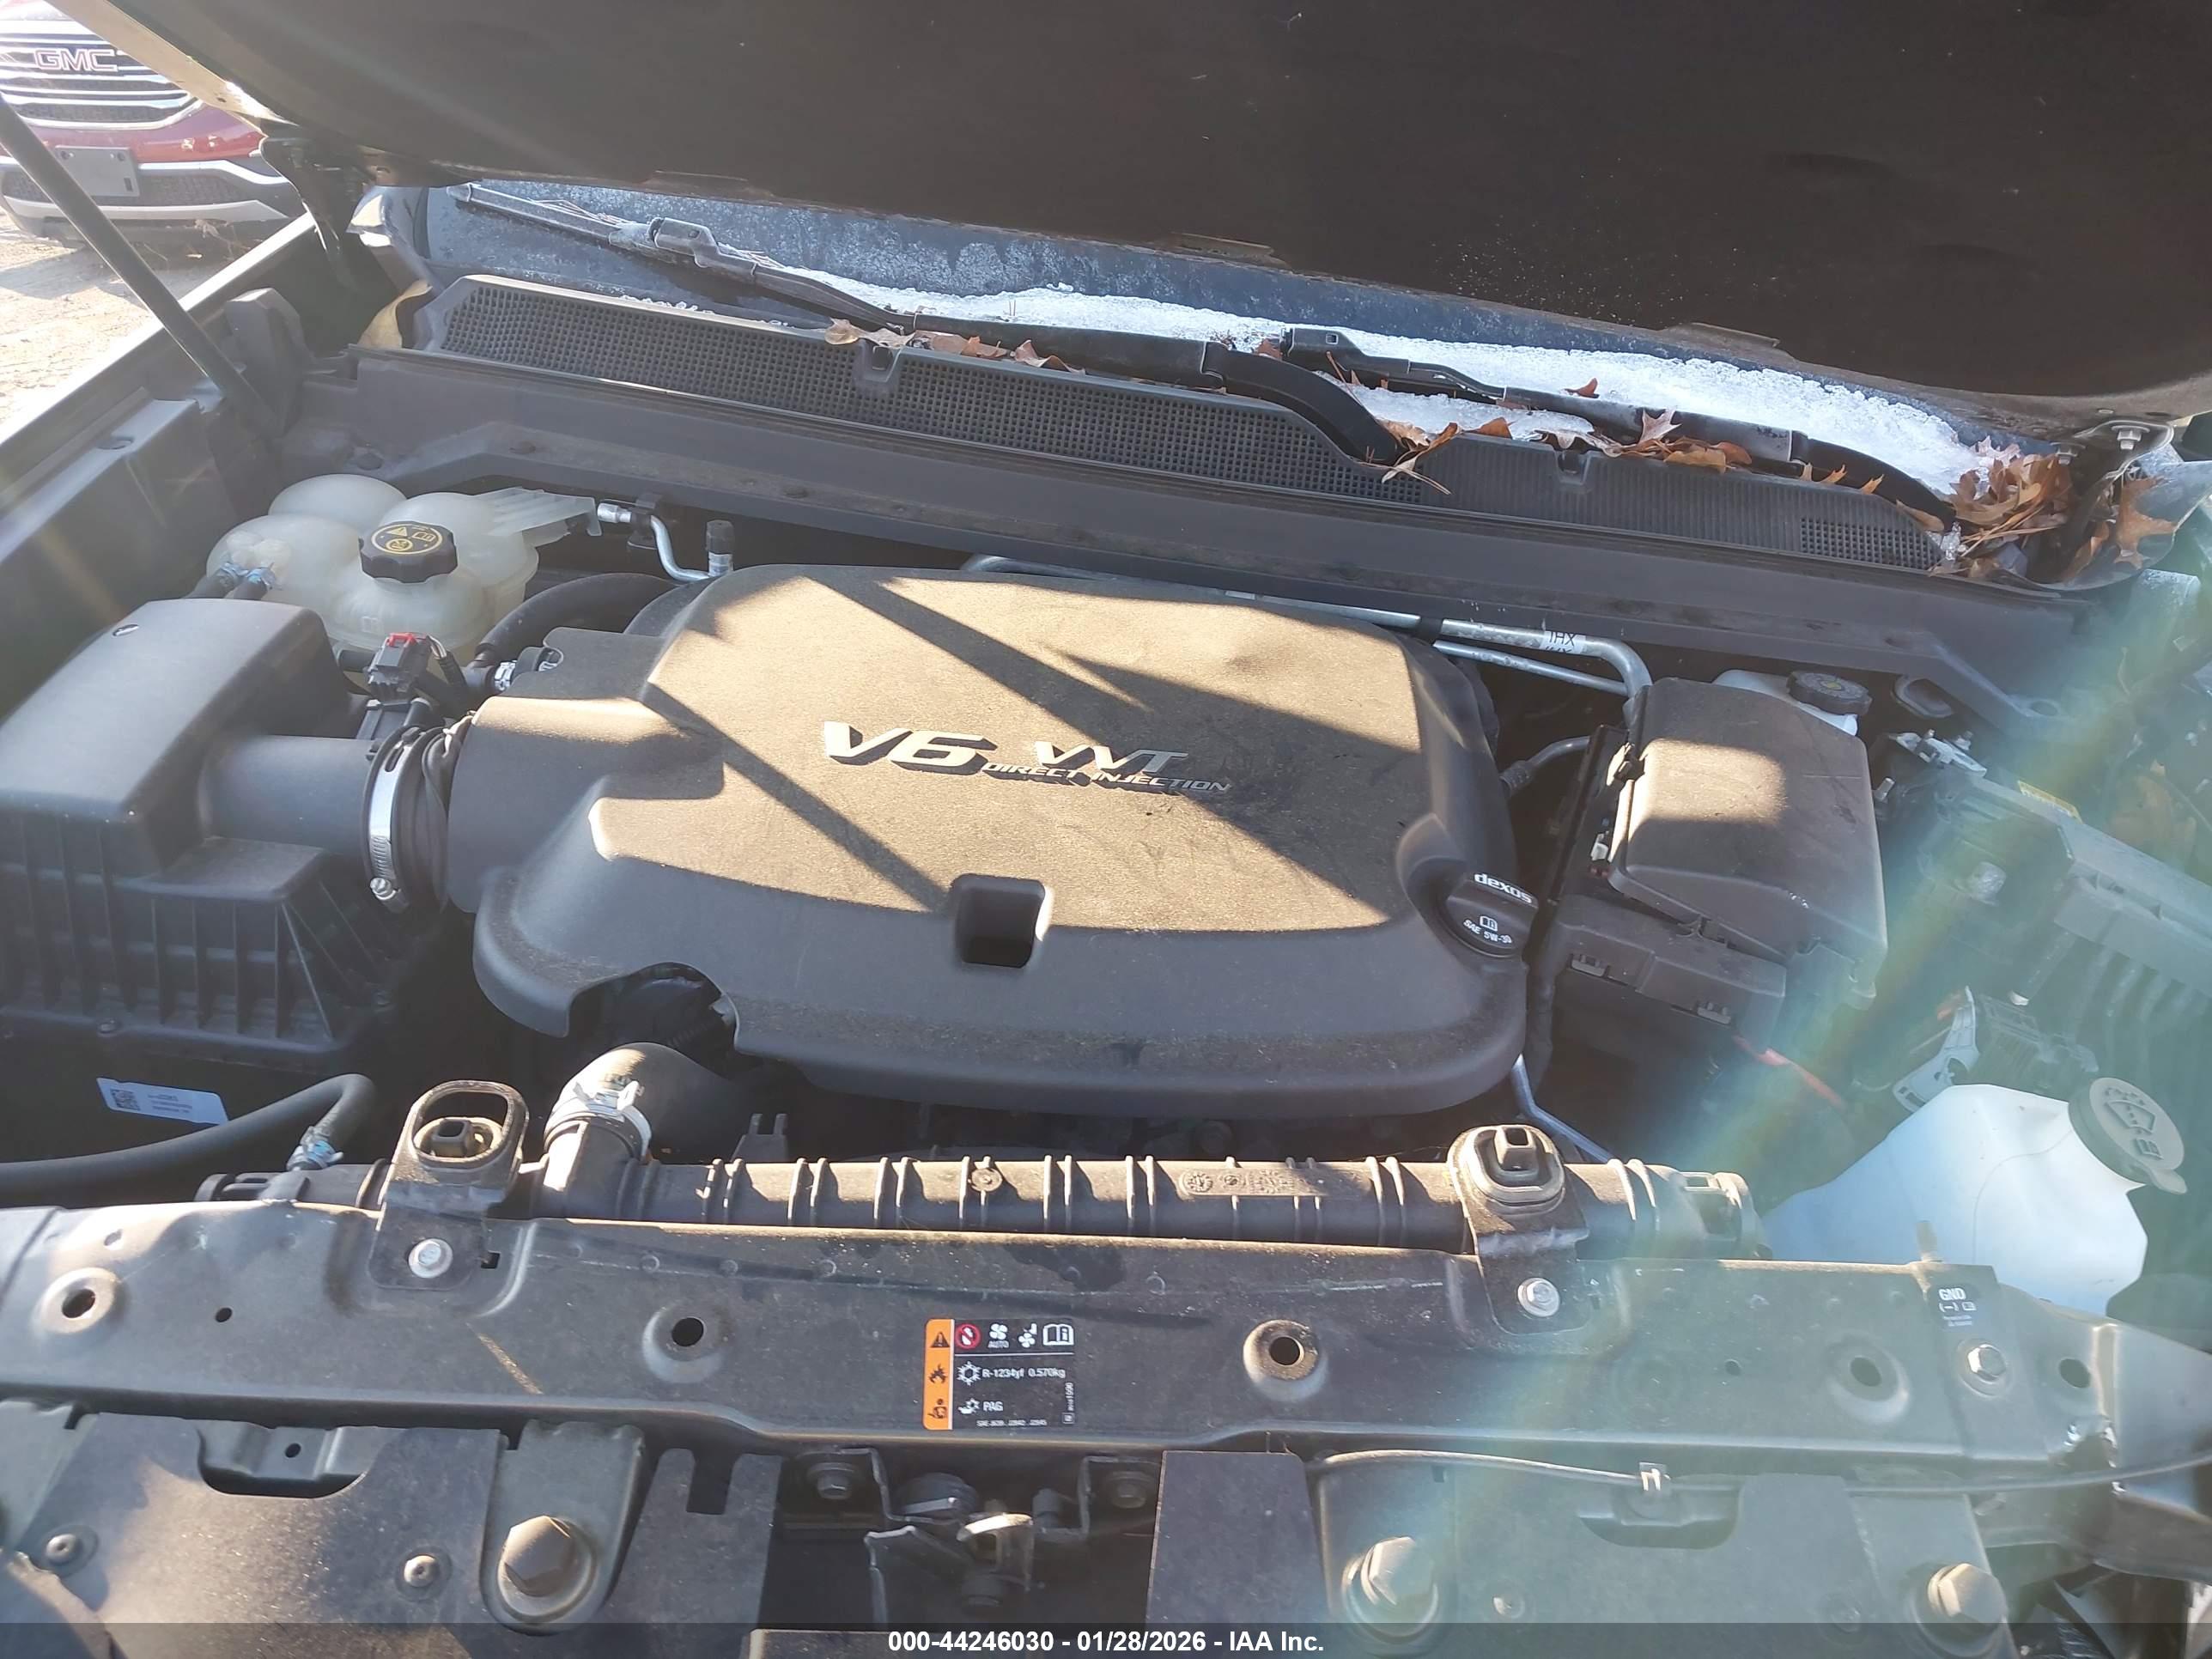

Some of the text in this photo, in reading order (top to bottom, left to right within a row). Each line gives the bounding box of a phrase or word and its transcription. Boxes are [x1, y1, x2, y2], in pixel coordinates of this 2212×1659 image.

[34, 48, 118, 73] GMC
[823, 720, 1189, 774] V6 VVT
[983, 762, 1231, 793] DIRECT INJECTION
[1474, 872, 1533, 903] dexos
[1463, 919, 1482, 935] SAE
[1938, 1287, 1966, 1301] GND
[982, 1401, 1004, 1412] PAG
